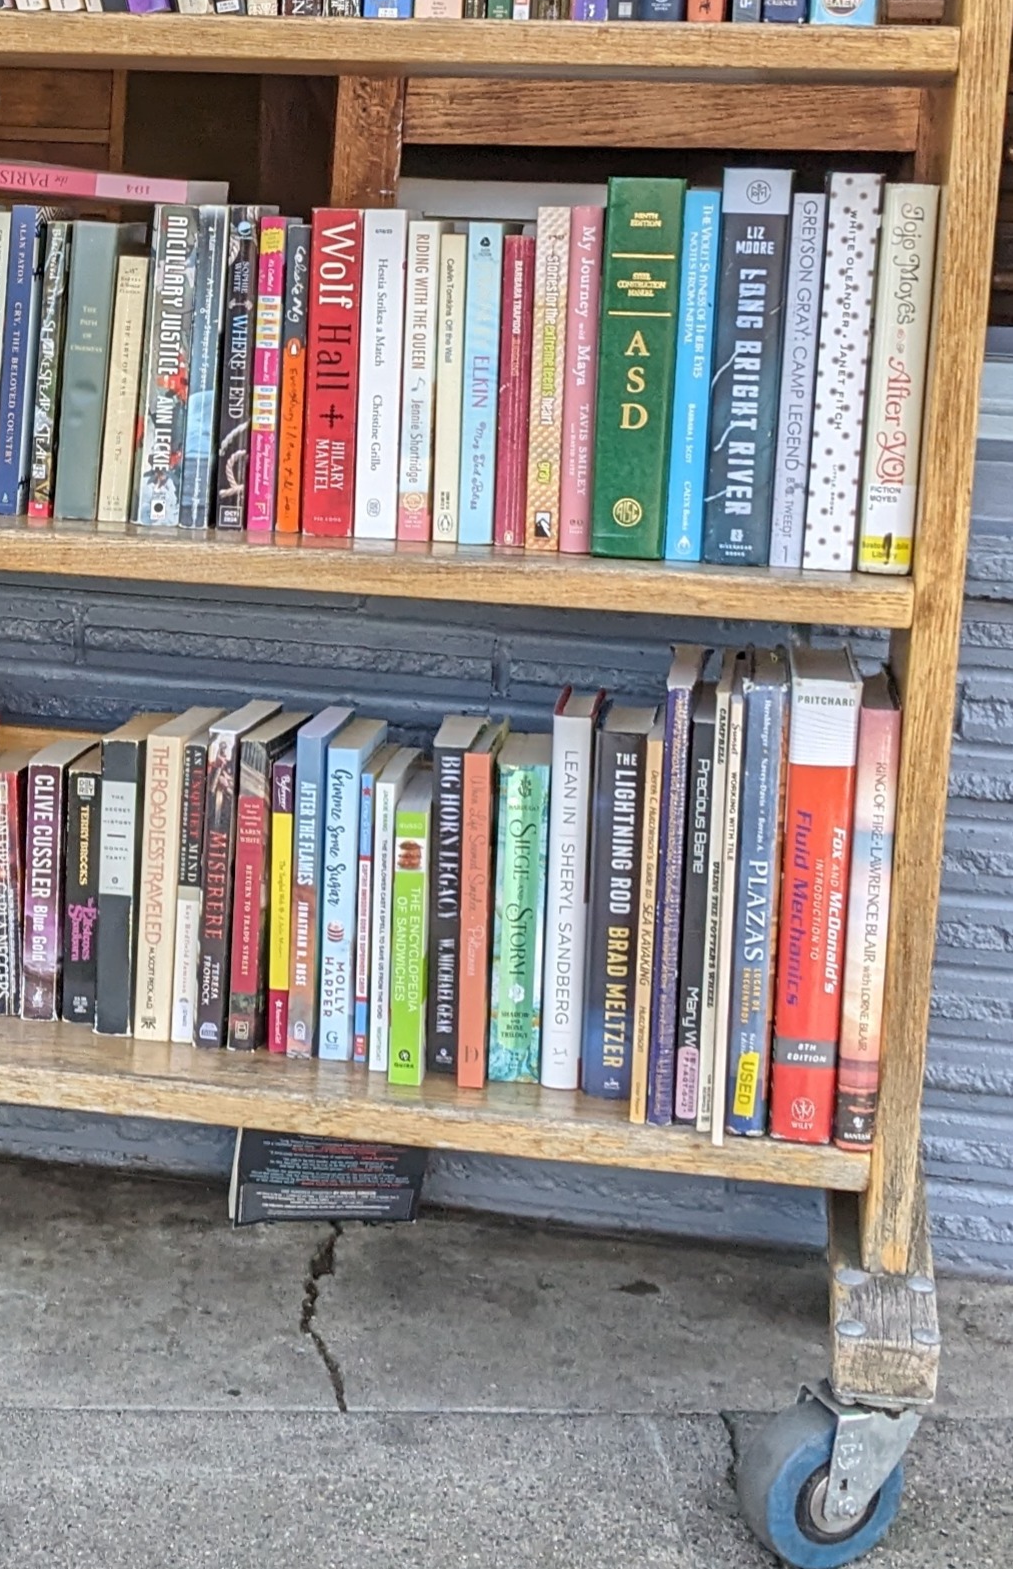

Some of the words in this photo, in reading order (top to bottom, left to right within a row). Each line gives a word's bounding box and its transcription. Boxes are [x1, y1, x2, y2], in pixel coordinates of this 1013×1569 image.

[736, 241, 774, 255] MOORE
[747, 226, 765, 239] LIZ
[161, 215, 187, 307] ANCILLARY
[736, 268, 767, 329] LONG
[158, 312, 183, 375] JUSTICE
[731, 340, 762, 431] BRIGHT
[313, 439, 330, 493] MANTEL
[329, 441, 345, 491] HILARY
[724, 442, 756, 515] RIVER
[870, 486, 901, 494] FICTION
[869, 495, 898, 503] MOYES
[797, 695, 856, 707] PRITCHARD
[440, 756, 461, 789] BIG
[564, 750, 578, 799] LEAN
[616, 753, 638, 766] THE
[33, 774, 55, 821] CLIVE
[301, 782, 317, 815] AFTER
[563, 808, 576, 825] IN
[695, 758, 710, 829] Precious
[729, 772, 738, 813] WORKING
[300, 818, 316, 836] THE
[439, 794, 461, 846] HORN
[611, 770, 637, 870] LIGHTNING
[728, 816, 736, 841] WITH
[793, 809, 813, 871] Fluid
[31, 826, 54, 899] CUSSLER
[297, 838, 315, 886] FLAMES
[692, 831, 707, 874] Bane
[437, 851, 459, 919] LEGACY
[558, 843, 576, 914] SHERYL
[610, 878, 632, 915] ROD
[32, 905, 48, 933] Blue
[743, 861, 768, 961] PLAZAS
[32, 936, 47, 962] Gold
[607, 926, 630, 978] BRAD
[786, 877, 810, 1006] Mechanics
[322, 957, 335, 1017] HARPER
[554, 921, 572, 1025] SANDBERG
[602, 983, 628, 1068] MELTZER
[786, 1053, 827, 1063] EDITION
[736, 1060, 755, 1105] USED
[791, 1121, 814, 1130] WILEY
[843, 1131, 872, 1141] BANTAM
